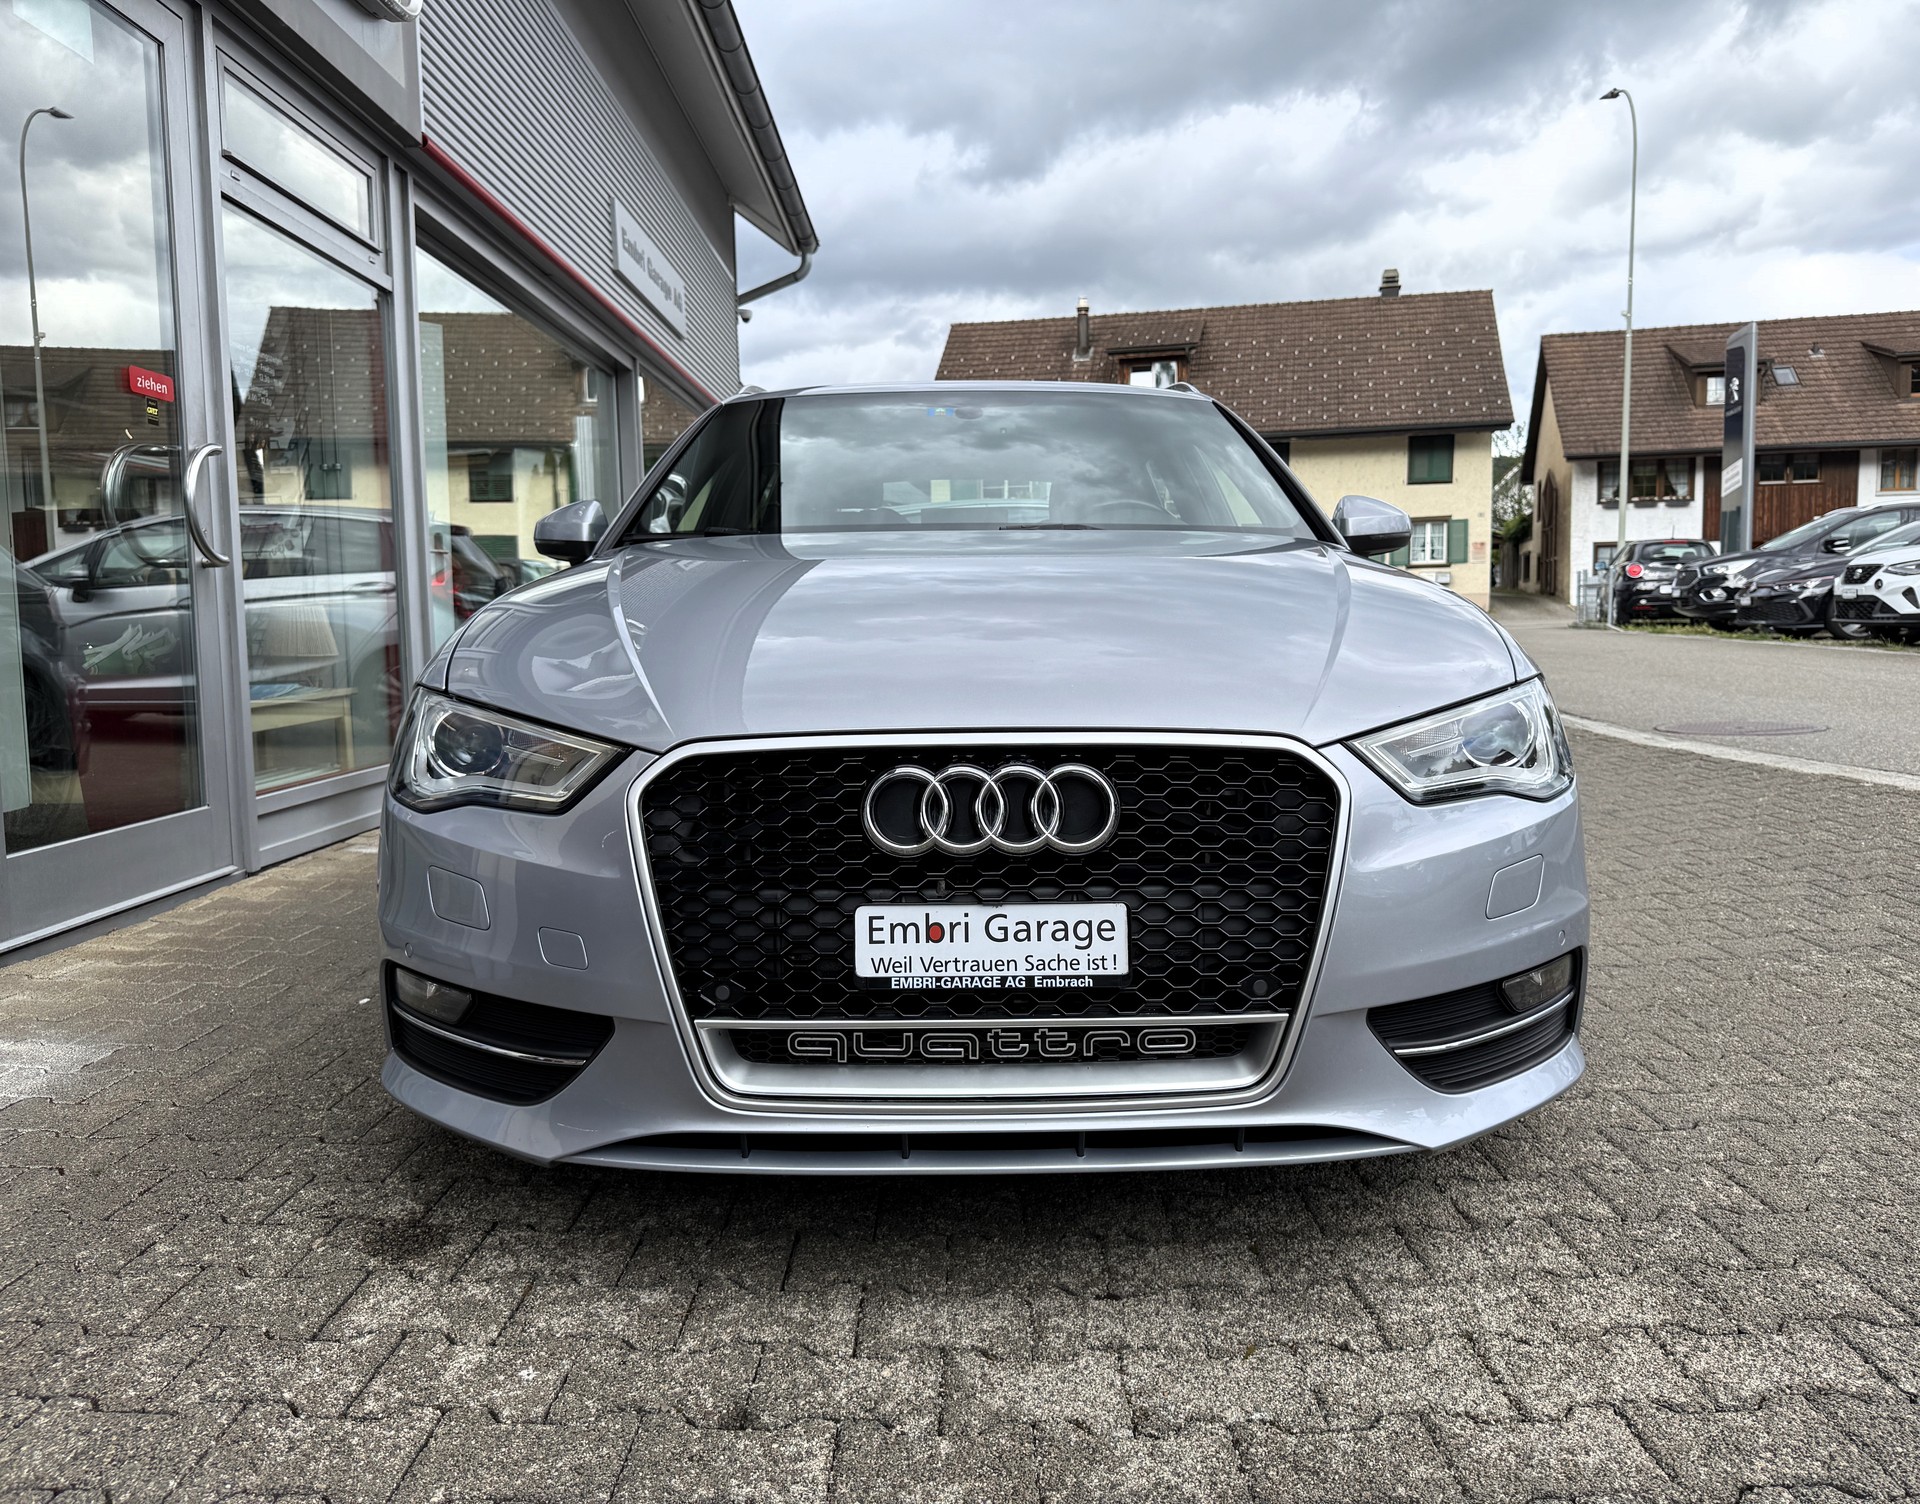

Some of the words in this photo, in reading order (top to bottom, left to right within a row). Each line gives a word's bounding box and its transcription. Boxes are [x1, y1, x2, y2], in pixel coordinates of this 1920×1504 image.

[621, 226, 646, 272] Embri
[647, 256, 672, 301] Garage
[673, 287, 684, 314] AG
[136, 375, 168, 395] ziehen
[867, 912, 970, 945] Embri
[983, 912, 1116, 950] Garage
[870, 956, 913, 974] Weil
[919, 955, 1018, 973] Vertrauen
[1024, 953, 1081, 972] Sache
[890, 976, 1002, 989] EMBRI-GARAGE
[1004, 976, 1026, 988] AG
[1034, 975, 1094, 988] Embrach
[787, 1028, 1197, 1064] quattro
